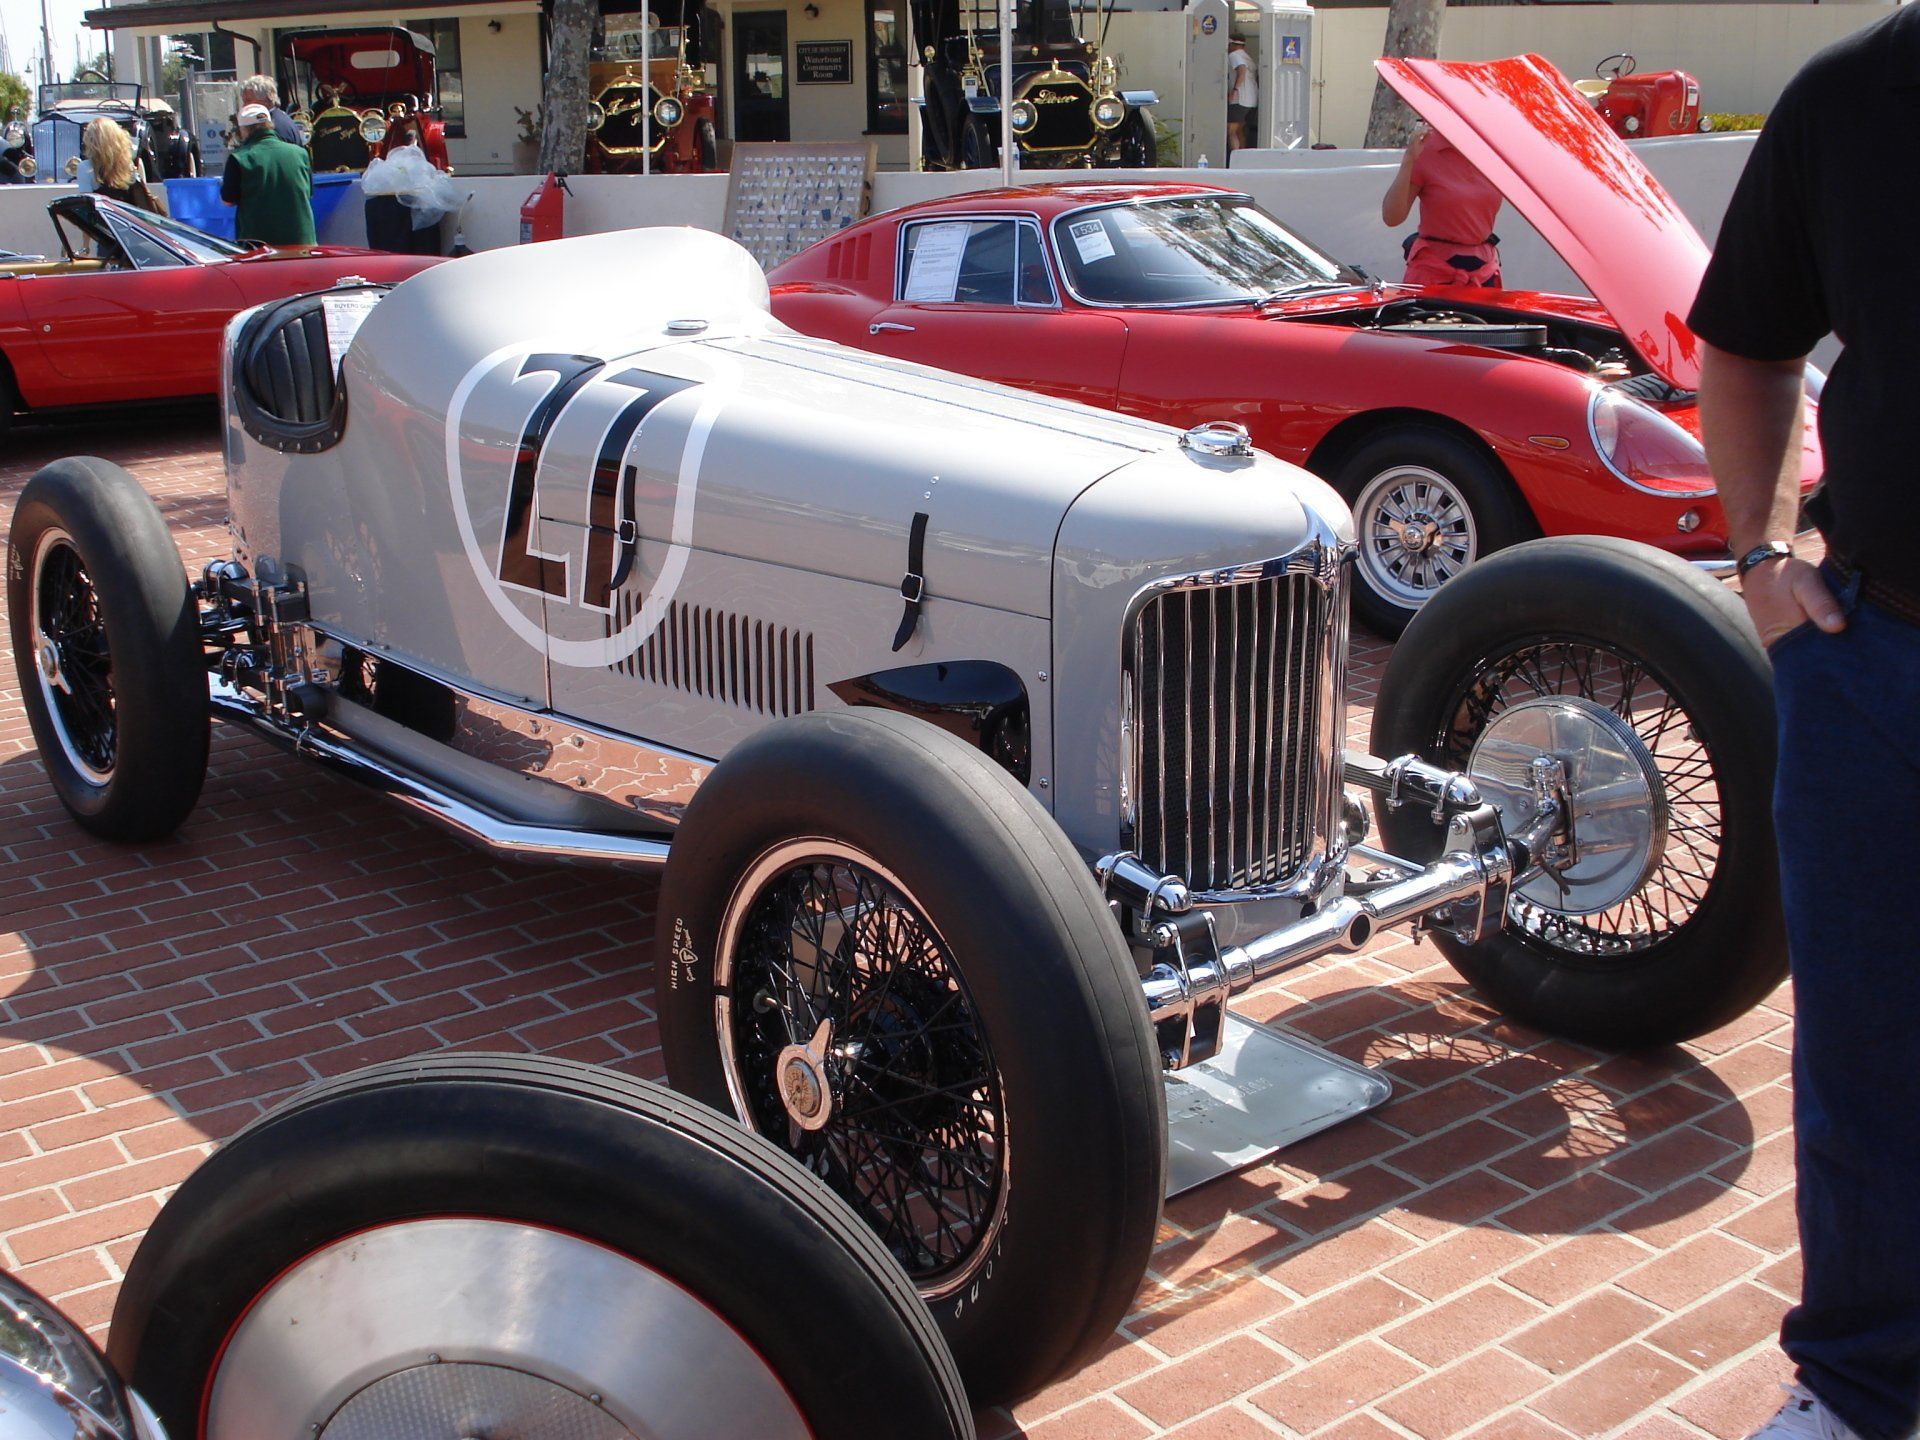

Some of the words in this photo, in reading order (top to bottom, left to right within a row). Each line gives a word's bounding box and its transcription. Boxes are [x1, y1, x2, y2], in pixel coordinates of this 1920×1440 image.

[802, 64, 843, 72] Community
[813, 71, 834, 79] Room
[1080, 223, 1099, 235] 534
[497, 353, 704, 615] 27
[672, 917, 683, 955] SPEED
